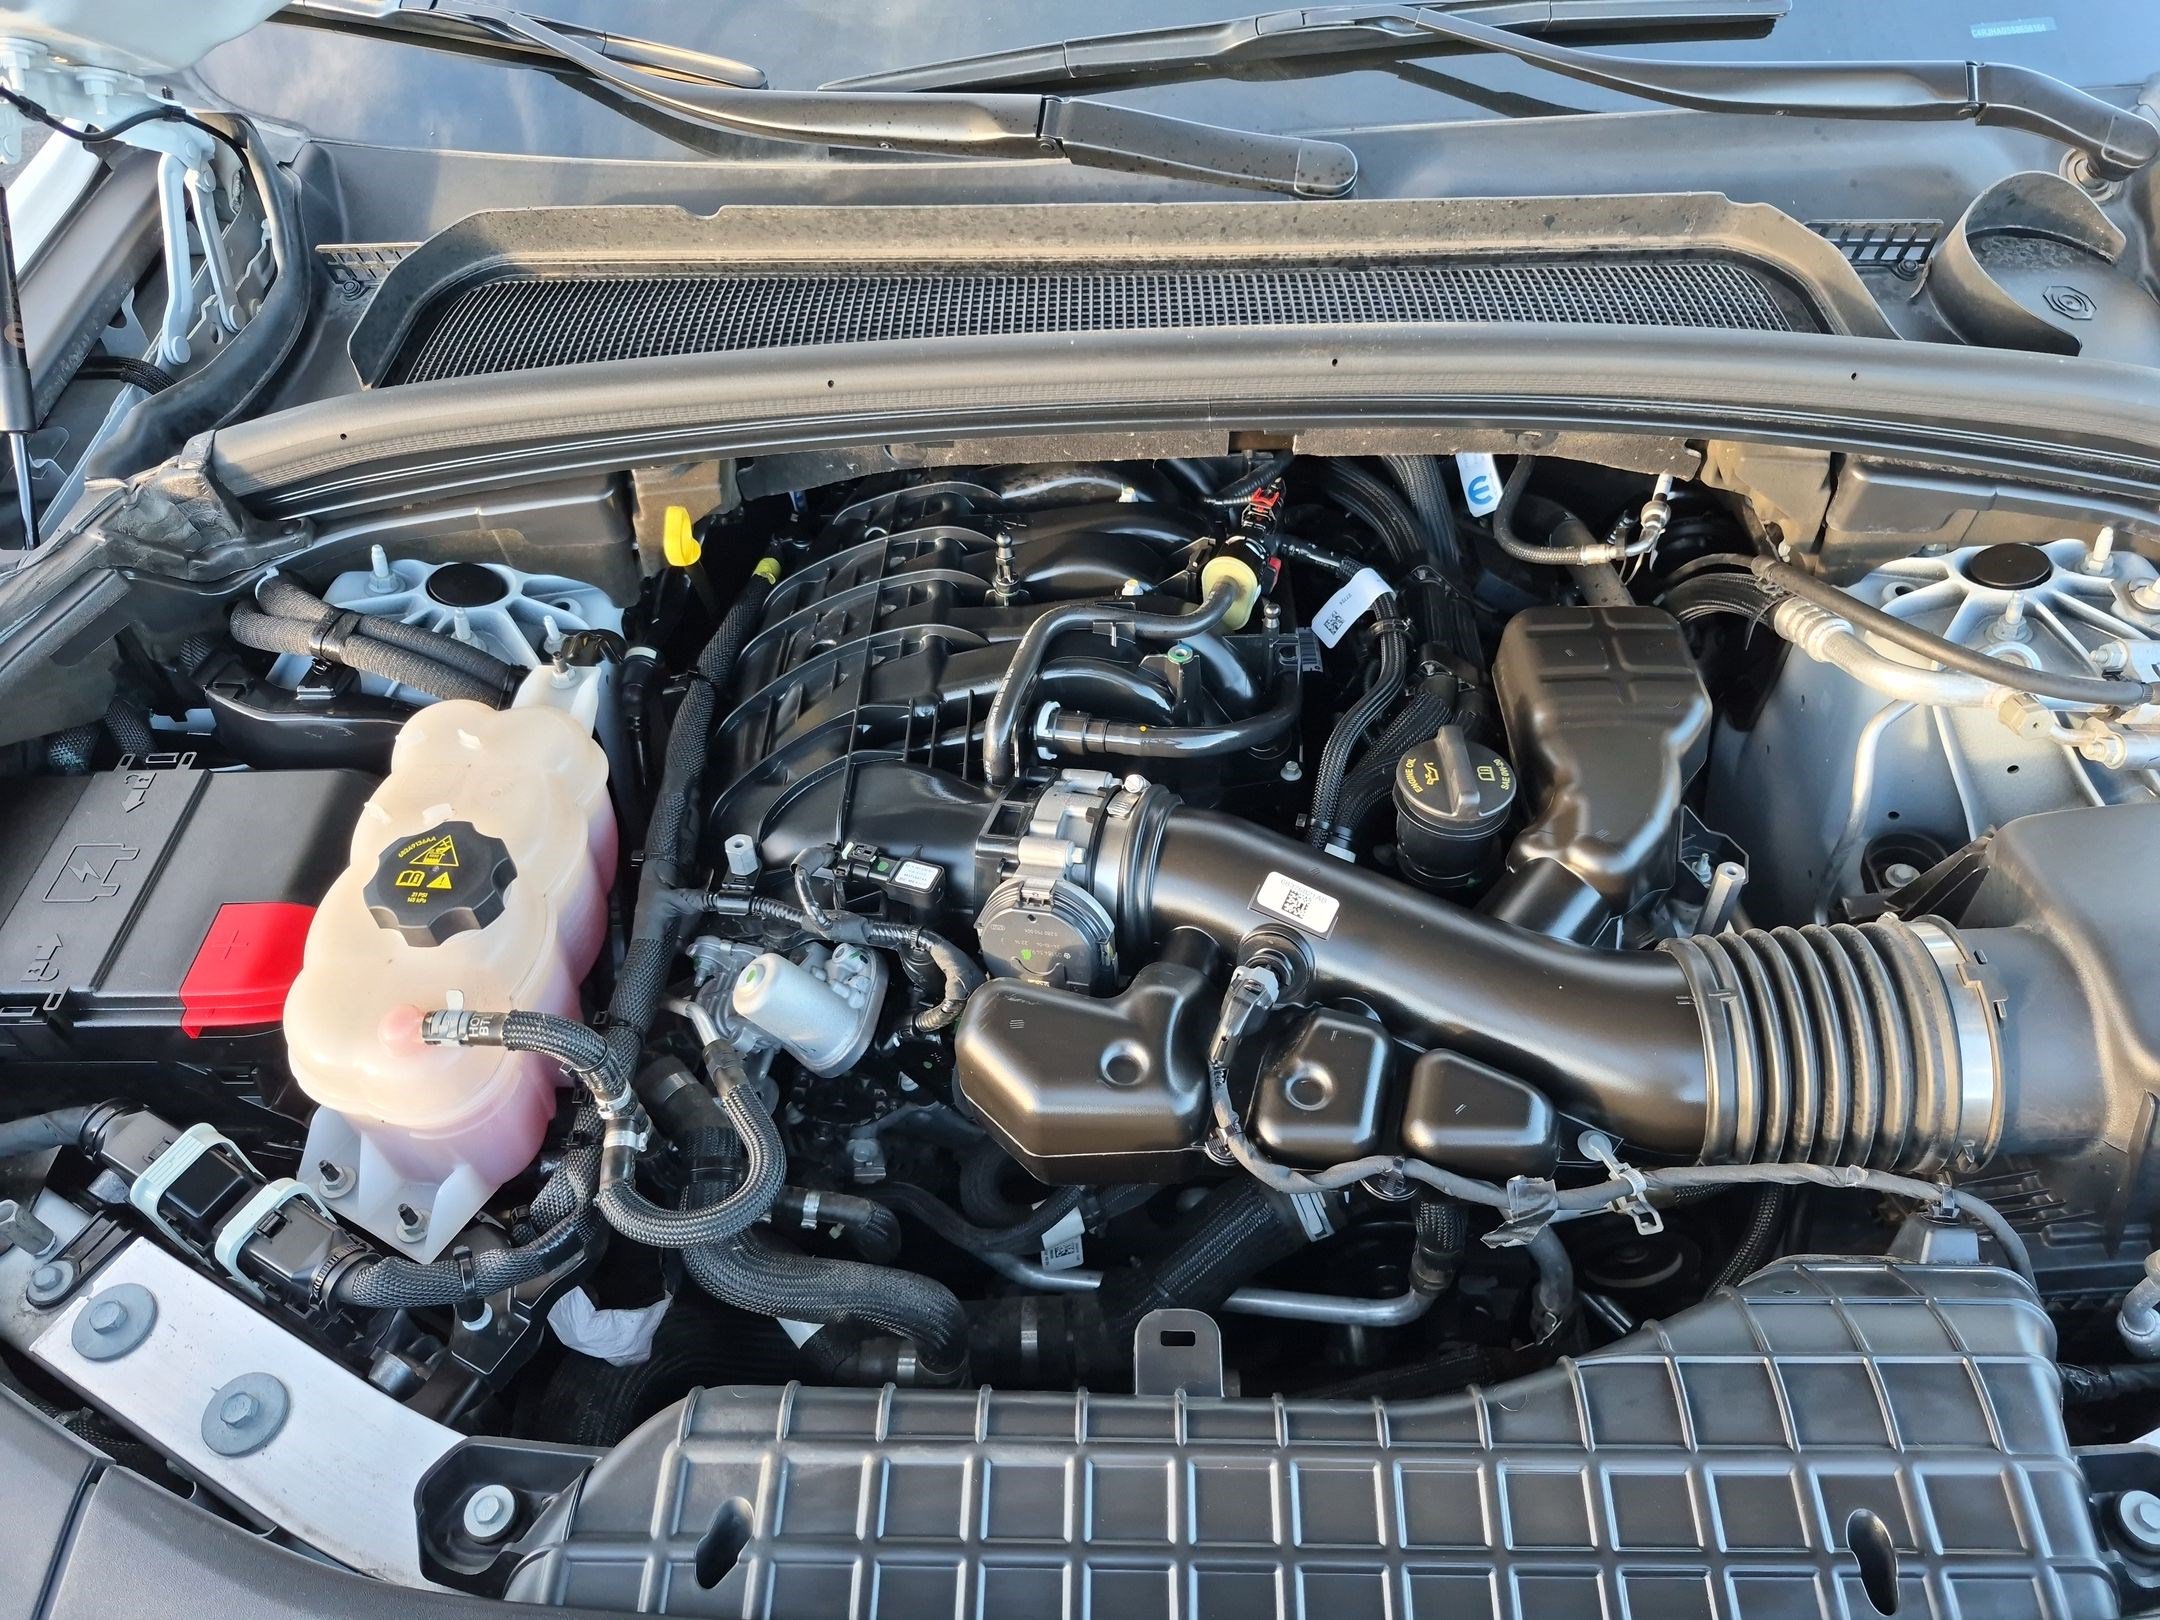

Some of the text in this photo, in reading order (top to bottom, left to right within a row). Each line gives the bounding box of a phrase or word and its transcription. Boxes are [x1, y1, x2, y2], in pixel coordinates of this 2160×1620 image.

[1405, 758, 1423, 793] ENGINE OIL
[1493, 758, 1510, 790] SAE 0W-20
